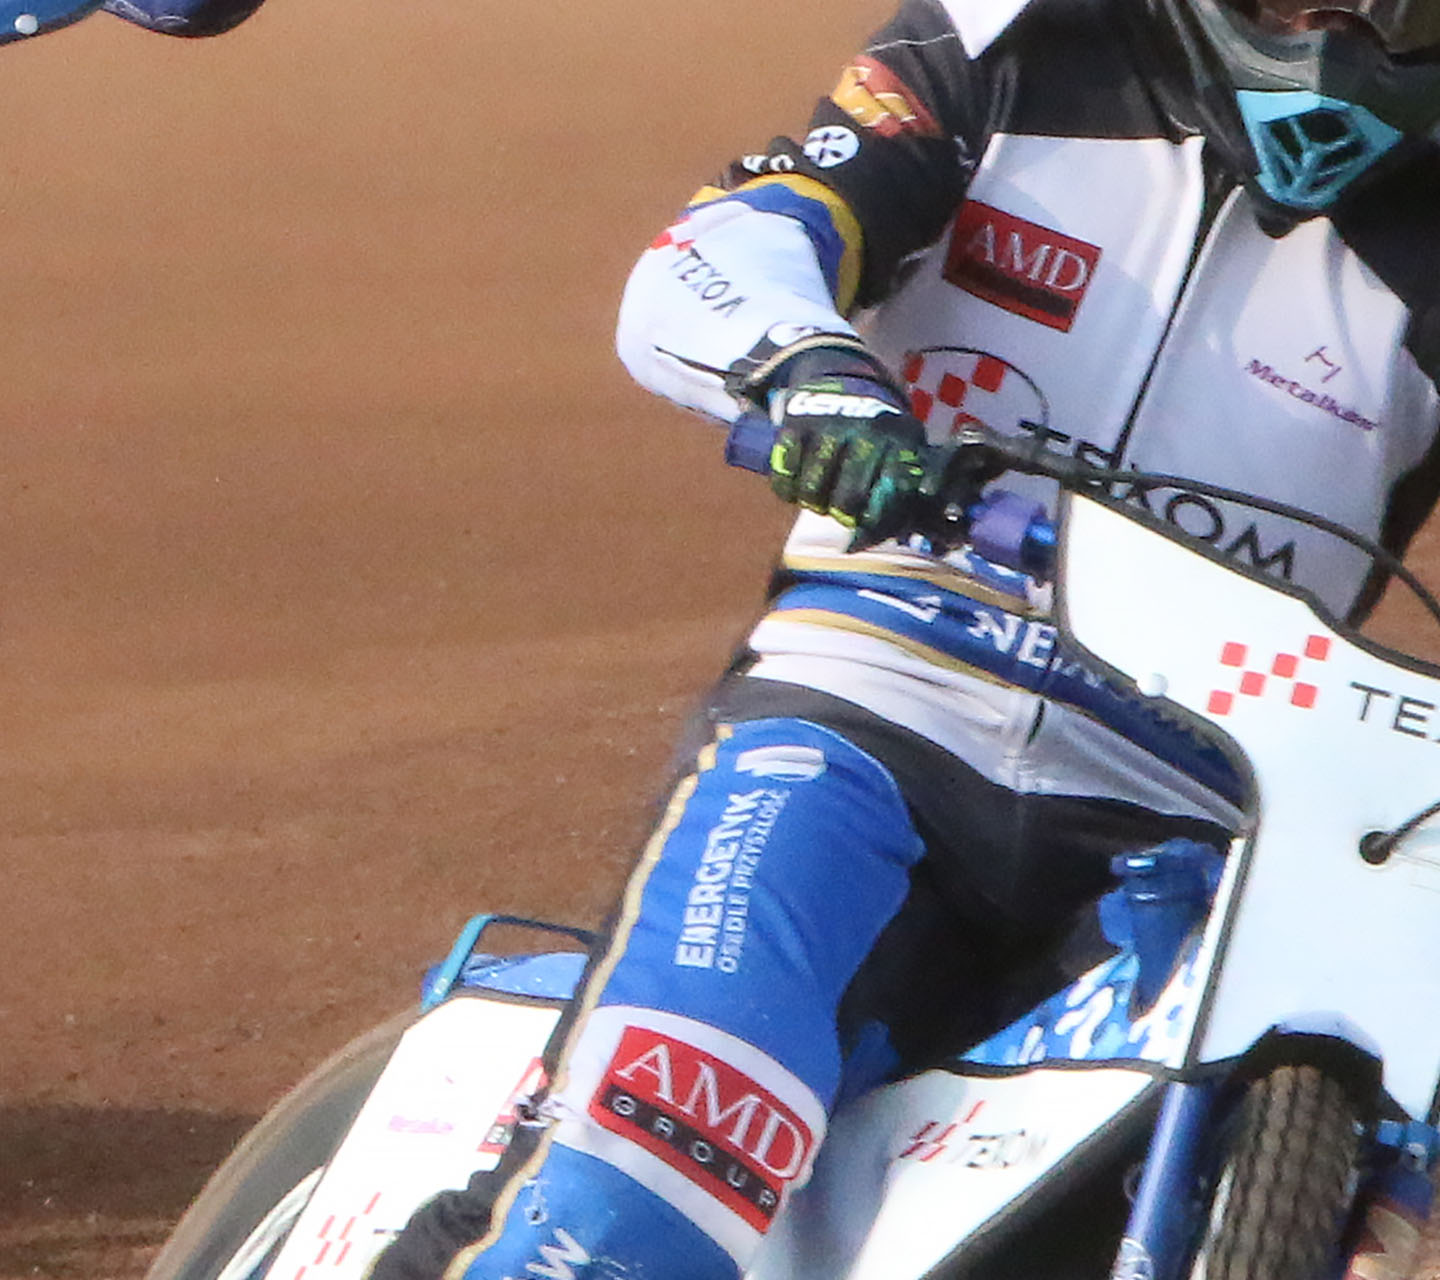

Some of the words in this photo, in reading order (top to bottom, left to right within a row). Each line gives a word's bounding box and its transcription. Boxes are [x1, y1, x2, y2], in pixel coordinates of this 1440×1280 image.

[967, 220, 1090, 291] AMD
[611, 1094, 778, 1208] GROUP
[613, 1042, 806, 1180] AMD
